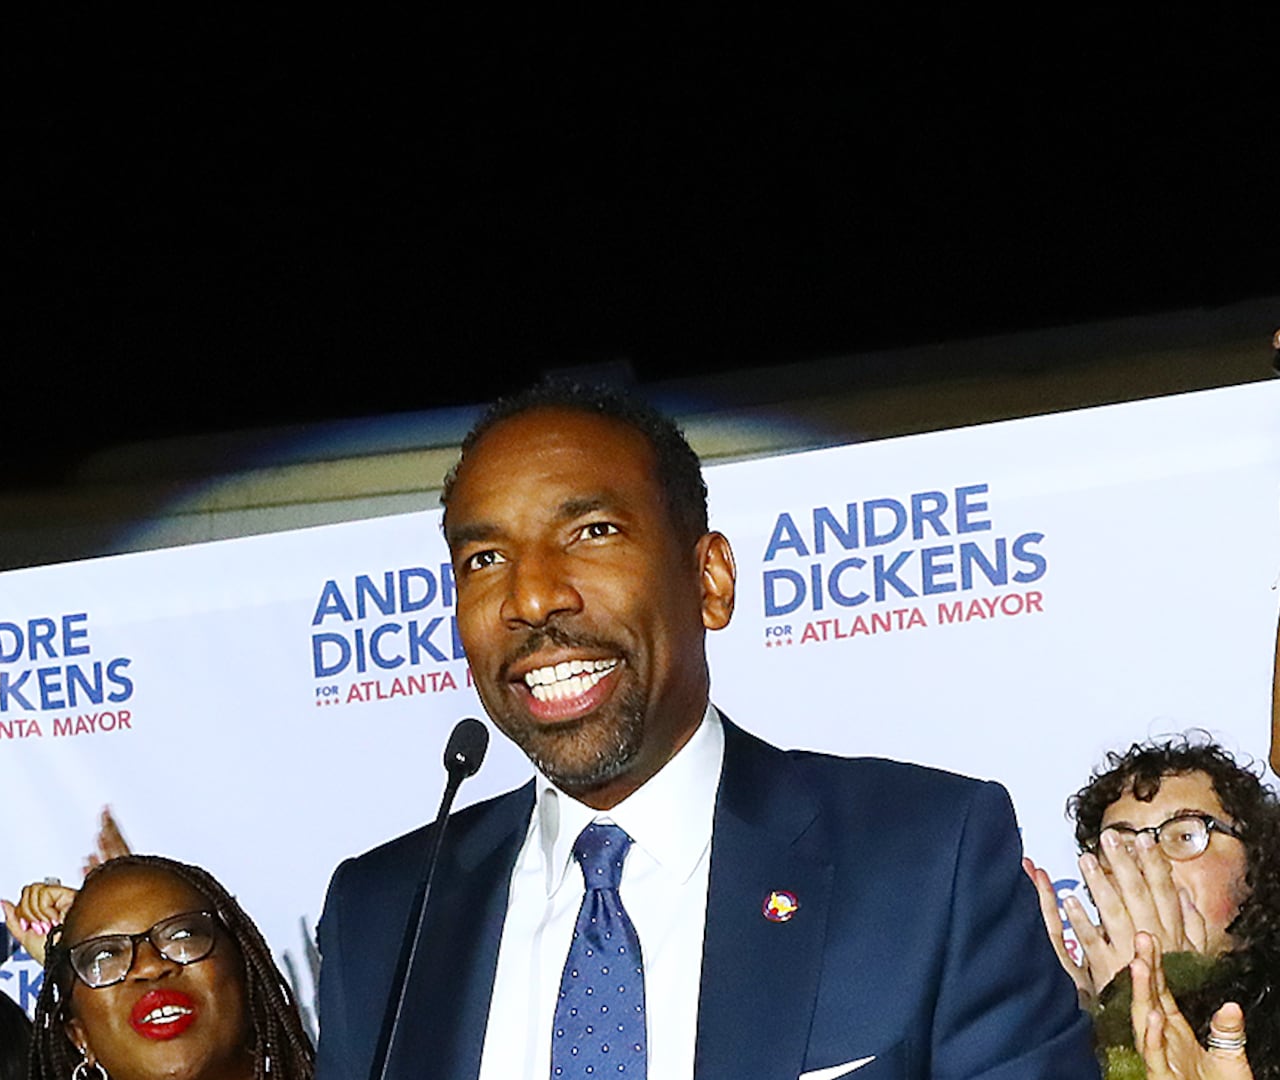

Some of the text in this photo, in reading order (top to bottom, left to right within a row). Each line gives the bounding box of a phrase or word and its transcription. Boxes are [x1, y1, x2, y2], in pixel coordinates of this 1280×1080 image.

[763, 483, 992, 562] ANDRE
[312, 563, 457, 626] AND
[763, 532, 1047, 617] DICKENS
[765, 591, 1044, 644] FOR ATLANTA MAYOR
[316, 686, 339, 697] FOR
[346, 670, 457, 703] ATLANTA
[53, 710, 132, 736] MAYOR
